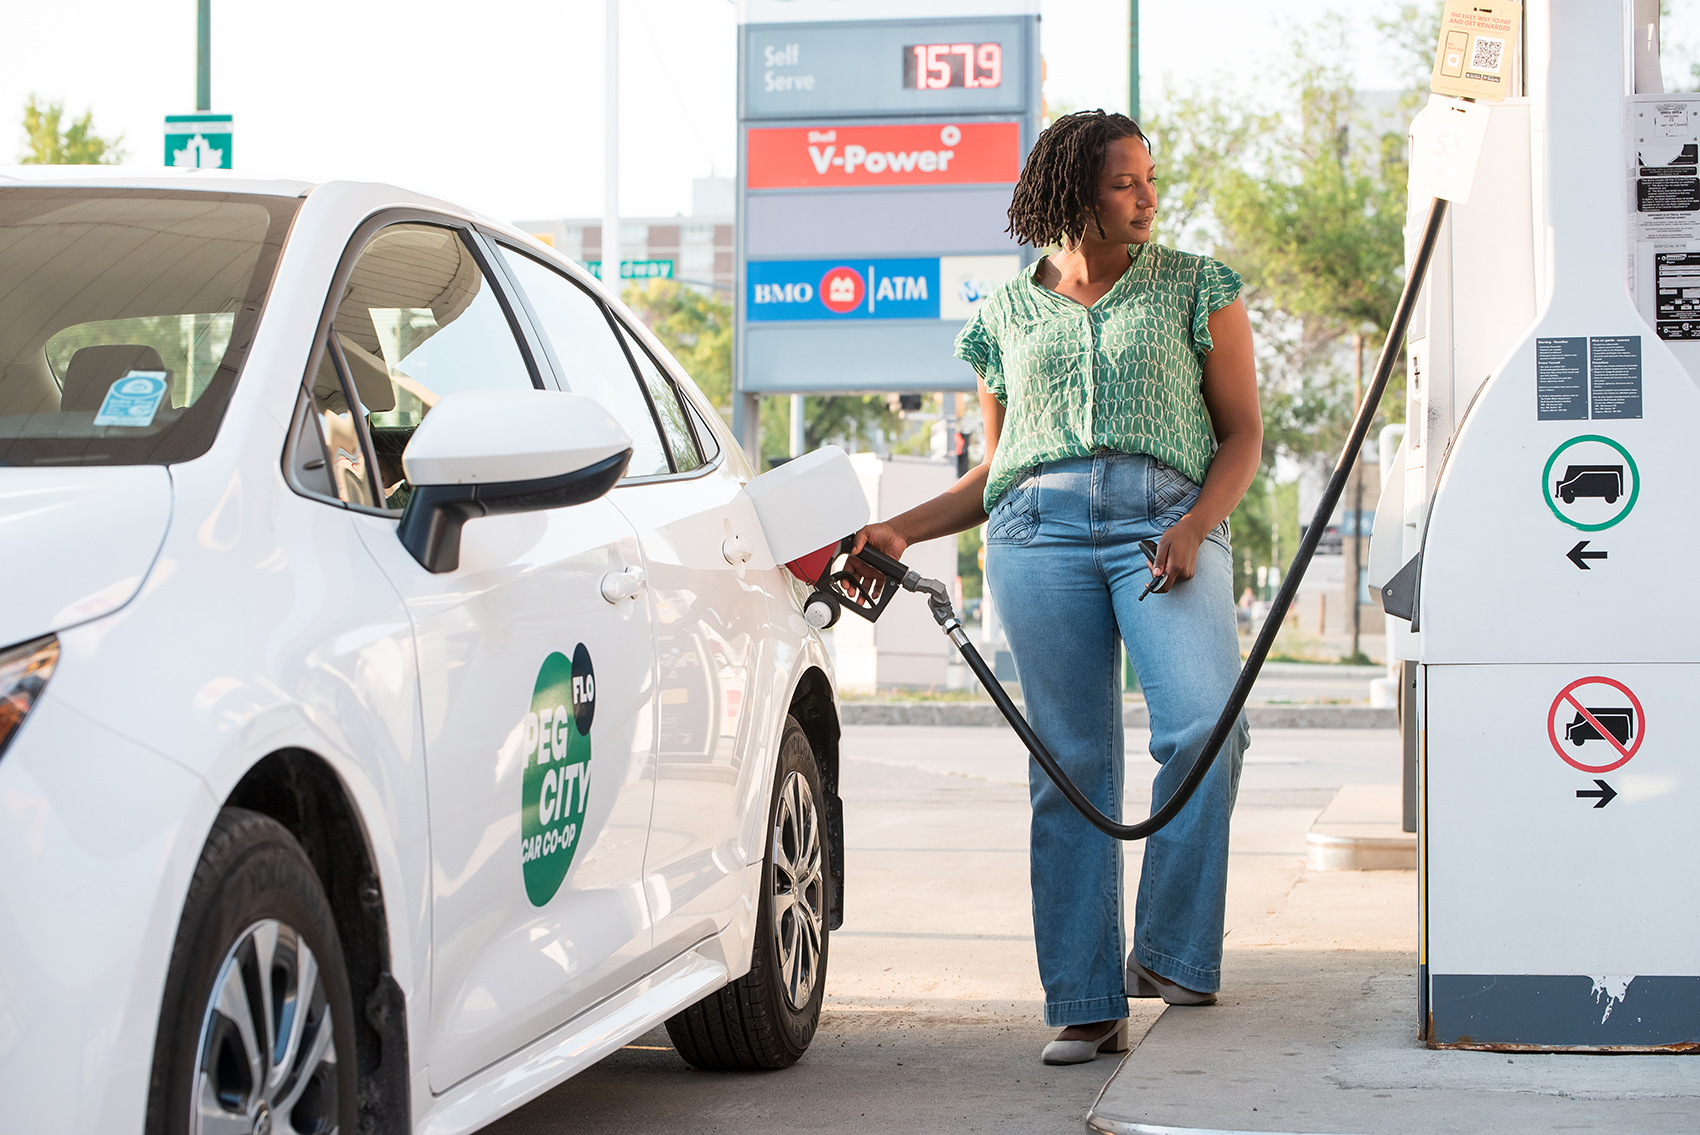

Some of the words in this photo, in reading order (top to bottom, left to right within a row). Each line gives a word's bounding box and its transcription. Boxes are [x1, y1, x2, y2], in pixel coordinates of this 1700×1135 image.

[1477, 21, 1511, 31] REWARDED
[763, 43, 799, 68] Self
[913, 43, 1002, 90] 157.9
[763, 69, 816, 92] Serve
[807, 130, 836, 143] Shell
[808, 145, 955, 174] V-Power
[754, 282, 814, 304] BMO
[876, 276, 929, 301] ATM
[572, 673, 594, 704] FLO
[522, 704, 569, 769] PEG
[538, 760, 592, 826] CITY
[521, 834, 543, 864] CAR
[542, 822, 576, 857] CO-OP
